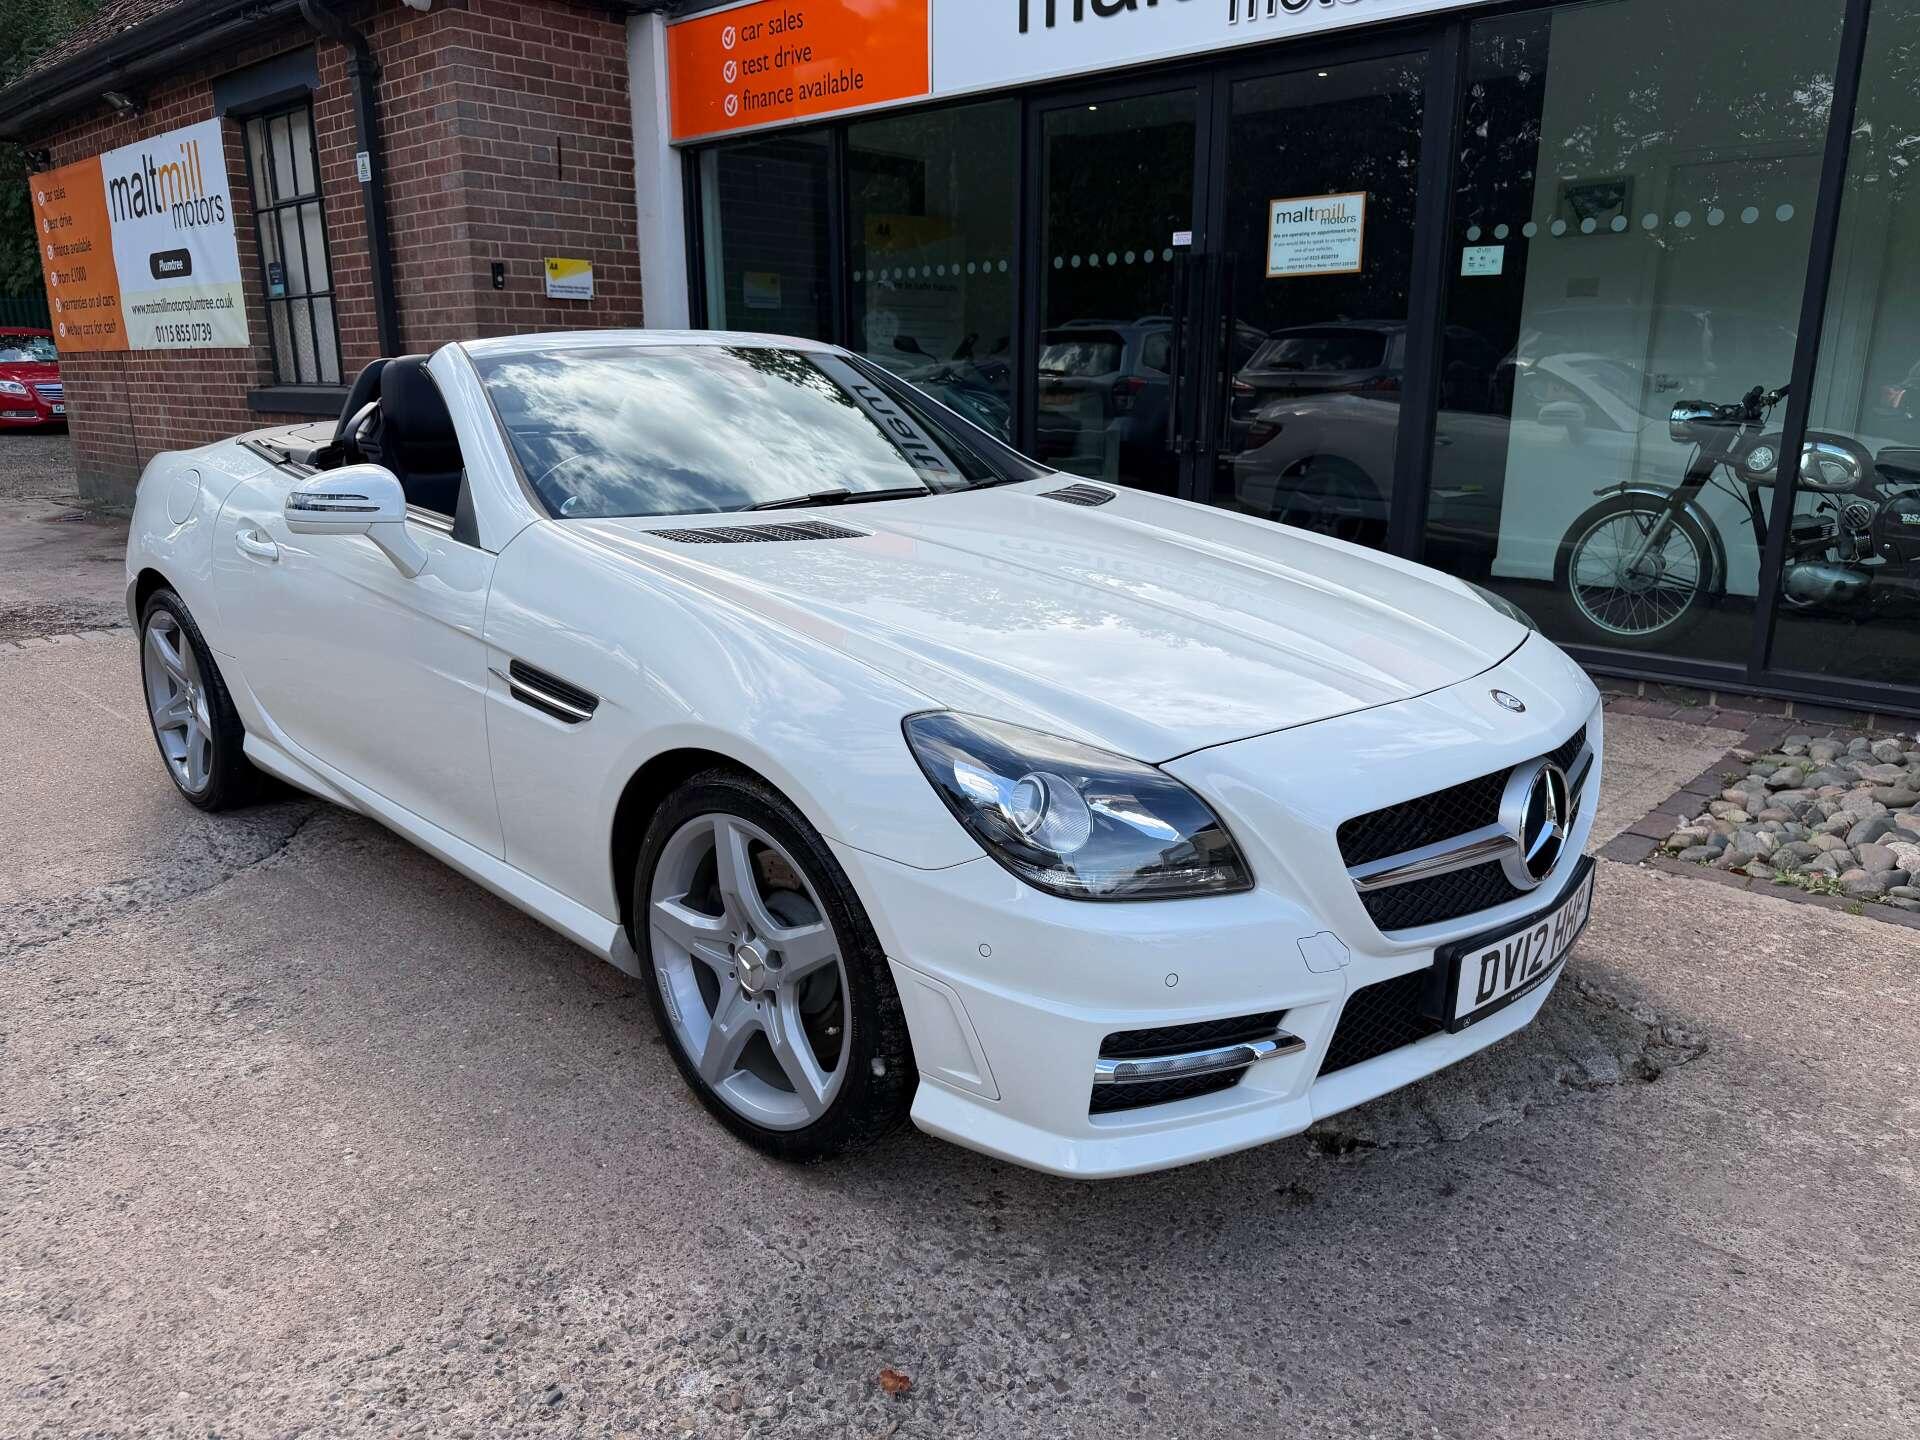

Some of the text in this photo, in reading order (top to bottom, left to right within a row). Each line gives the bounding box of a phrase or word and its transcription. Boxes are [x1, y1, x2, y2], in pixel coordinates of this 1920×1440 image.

[741, 8, 803, 41] car sales
[742, 45, 812, 76] test drive
[743, 67, 864, 111] finance available
[109, 140, 203, 222] maltmill
[60, 212, 73, 228] drive
[172, 192, 225, 229] motors
[1276, 203, 1345, 225] maltmill
[1320, 215, 1357, 225] motors
[159, 259, 184, 272] Plumtree
[57, 270, 70, 284] from
[103, 295, 116, 307] cars
[155, 323, 212, 343] 0115 855 0739
[1901, 513, 1920, 522] BS
[1475, 923, 1550, 1006] DV12
